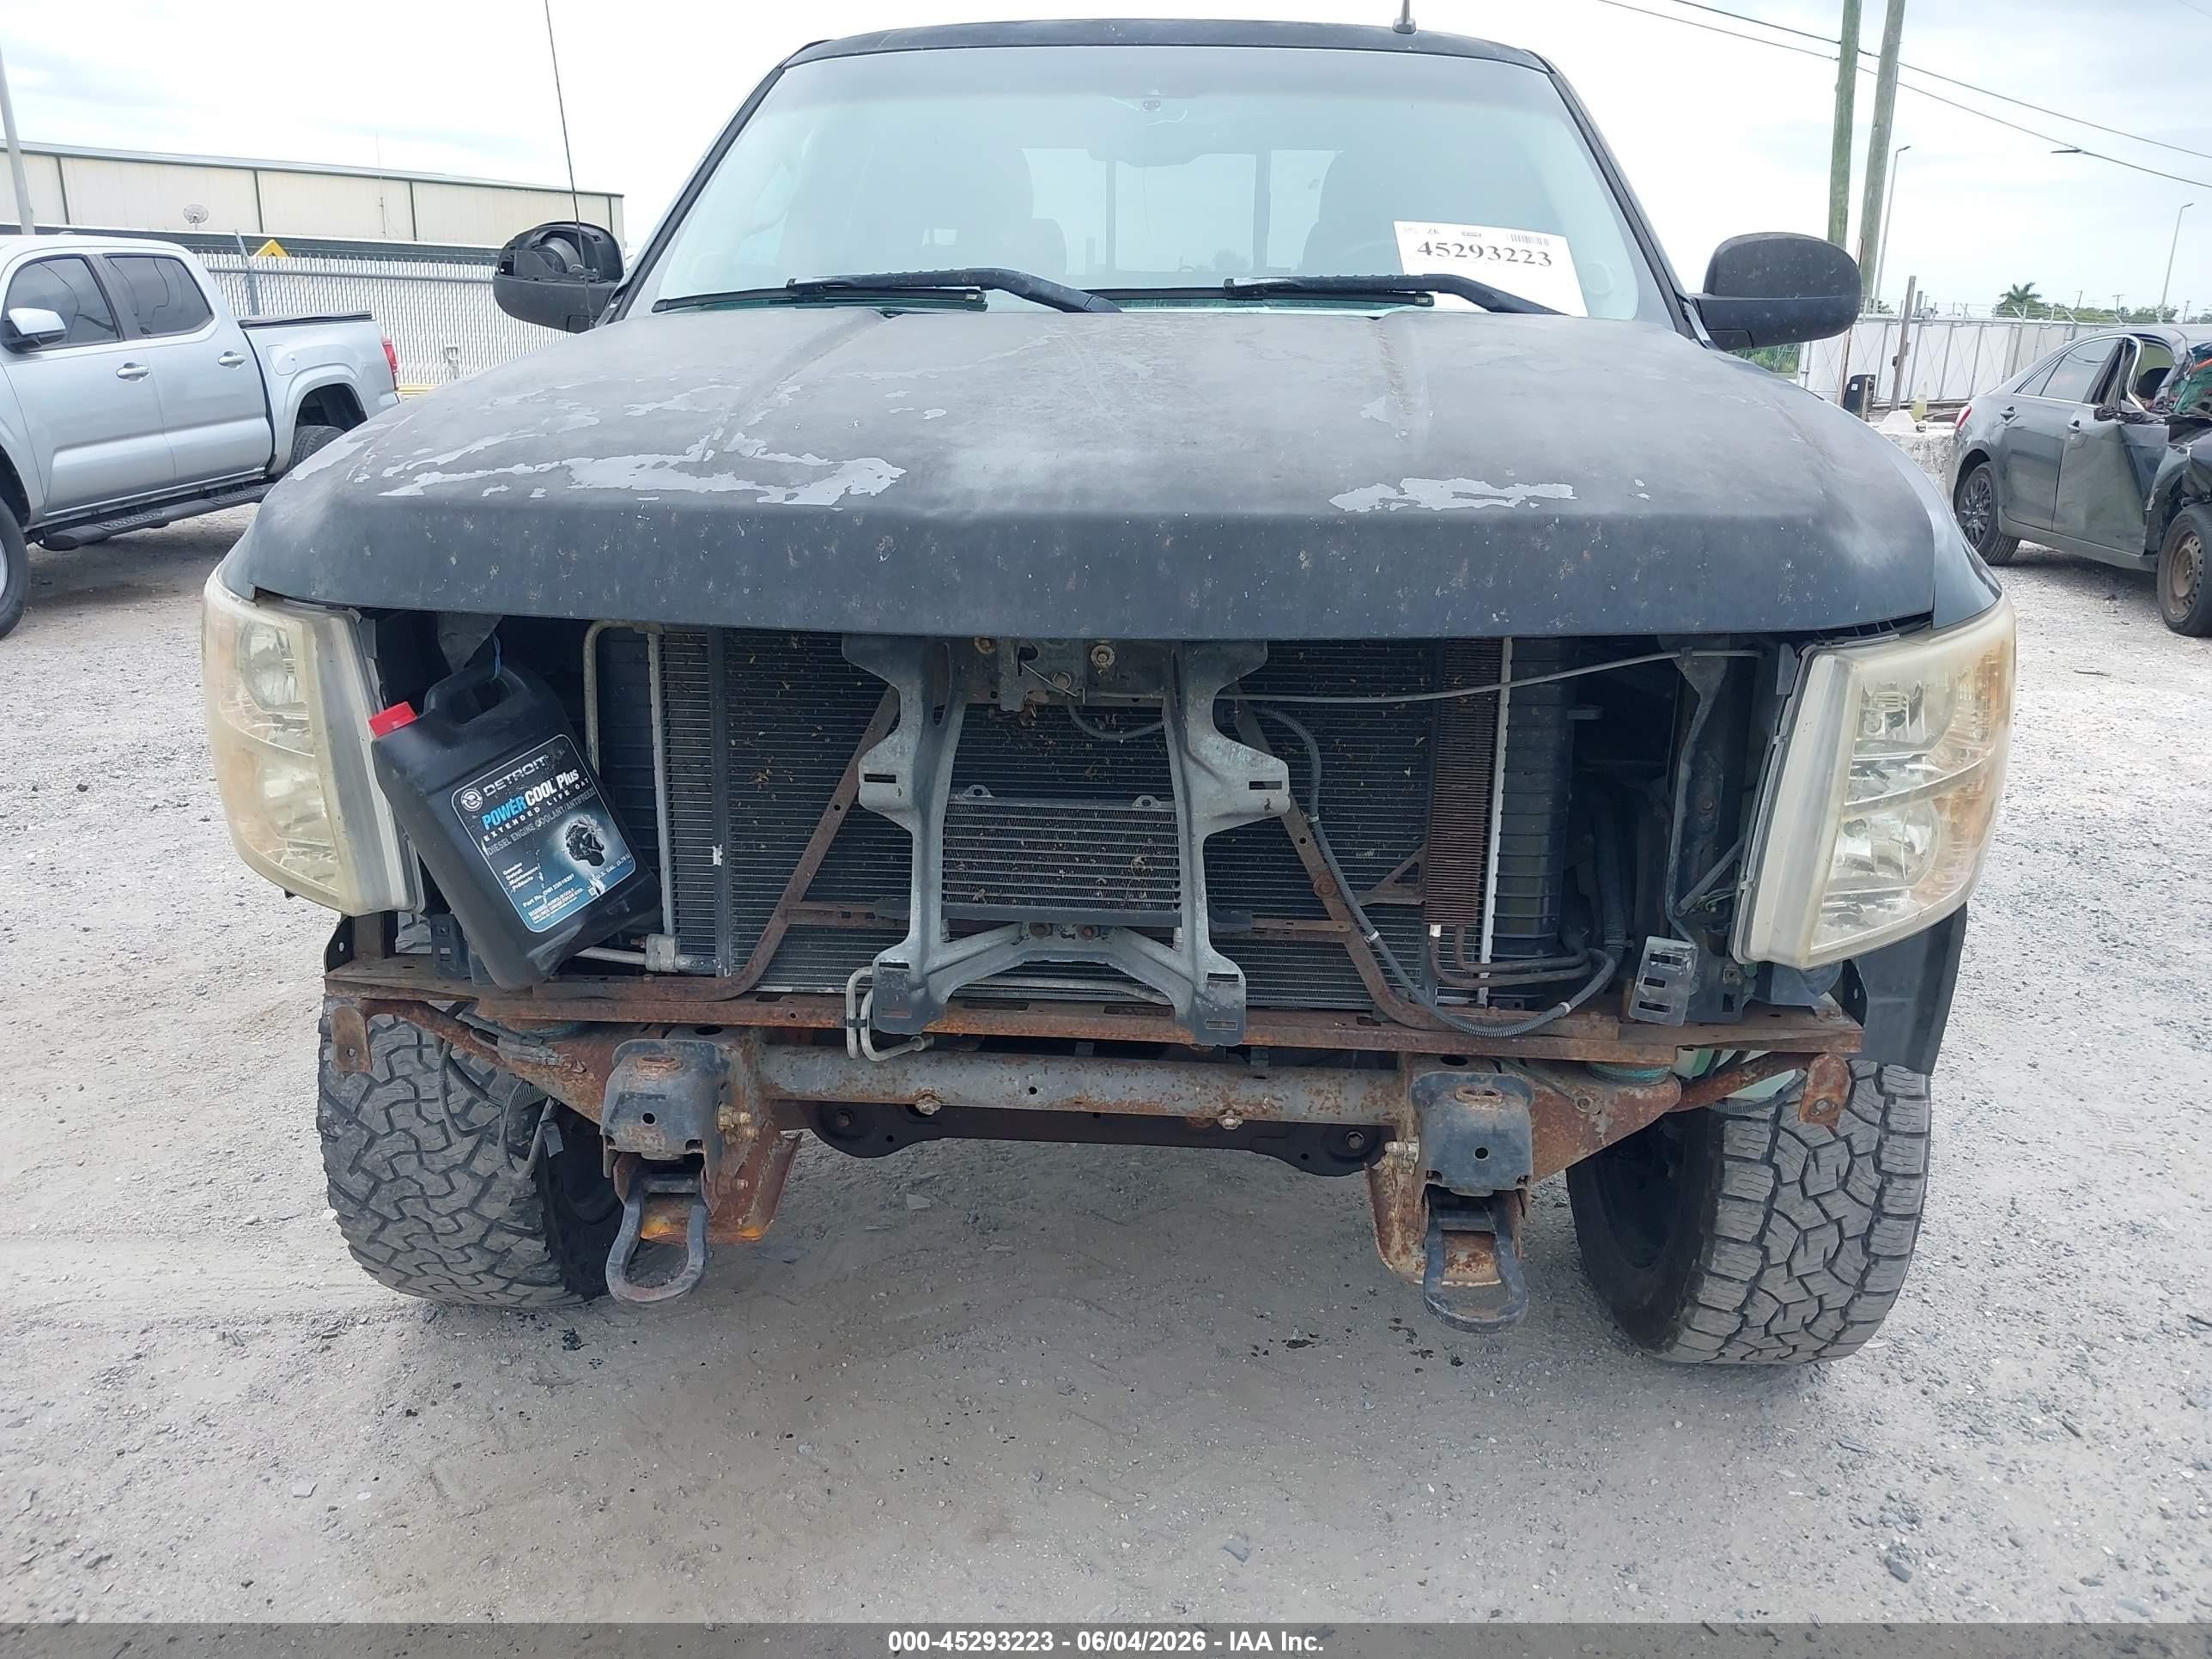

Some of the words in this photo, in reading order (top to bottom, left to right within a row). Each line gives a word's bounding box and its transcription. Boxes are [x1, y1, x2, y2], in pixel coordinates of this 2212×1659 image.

[1418, 240, 1553, 267] 45293223
[482, 755, 548, 797] DETROIT
[556, 767, 580, 789] Plus
[483, 805, 541, 842] EXTENDED
[546, 788, 570, 805] LIFE
[574, 777, 588, 790] OAT
[487, 836, 512, 855] DIESEL
[510, 822, 536, 842] ENGINE
[522, 897, 534, 908] Part
